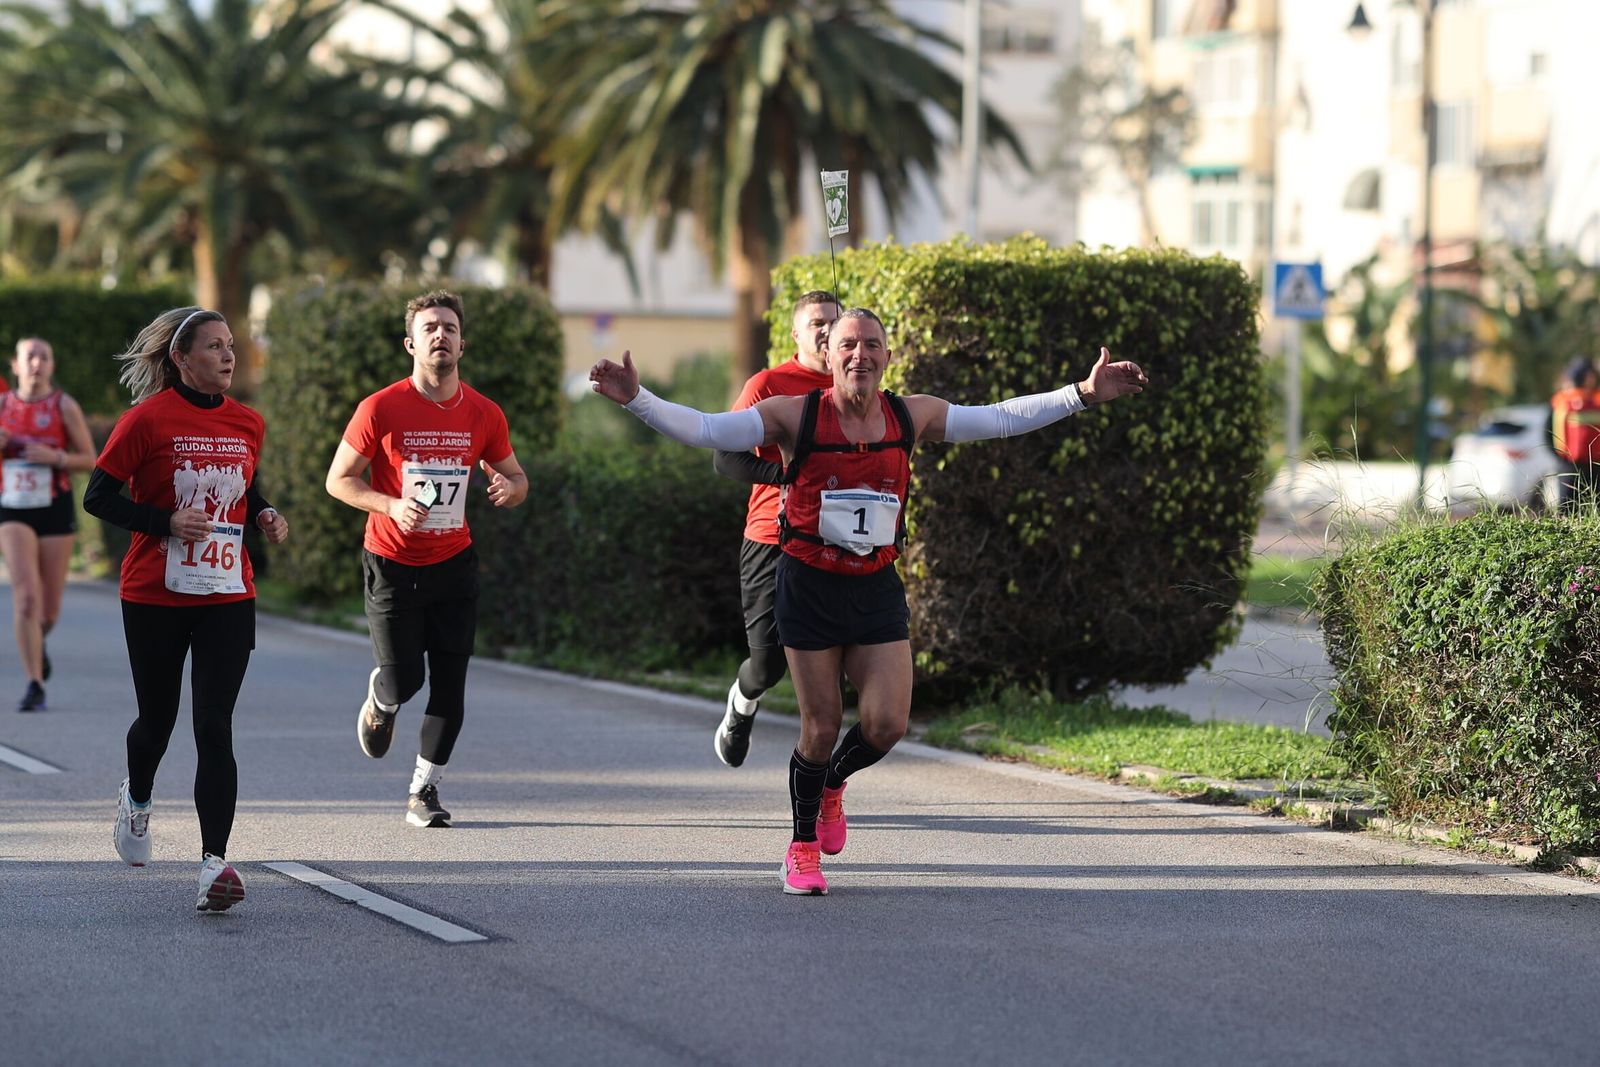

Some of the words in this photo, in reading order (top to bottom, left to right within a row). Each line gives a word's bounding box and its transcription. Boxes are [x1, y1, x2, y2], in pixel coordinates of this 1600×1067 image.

[174, 443, 213, 452] CIUDAD
[216, 444, 247, 454] JARDÍN
[440, 437, 471, 446] JARDÍN
[853, 508, 868, 535] 1
[181, 540, 235, 570] 146
